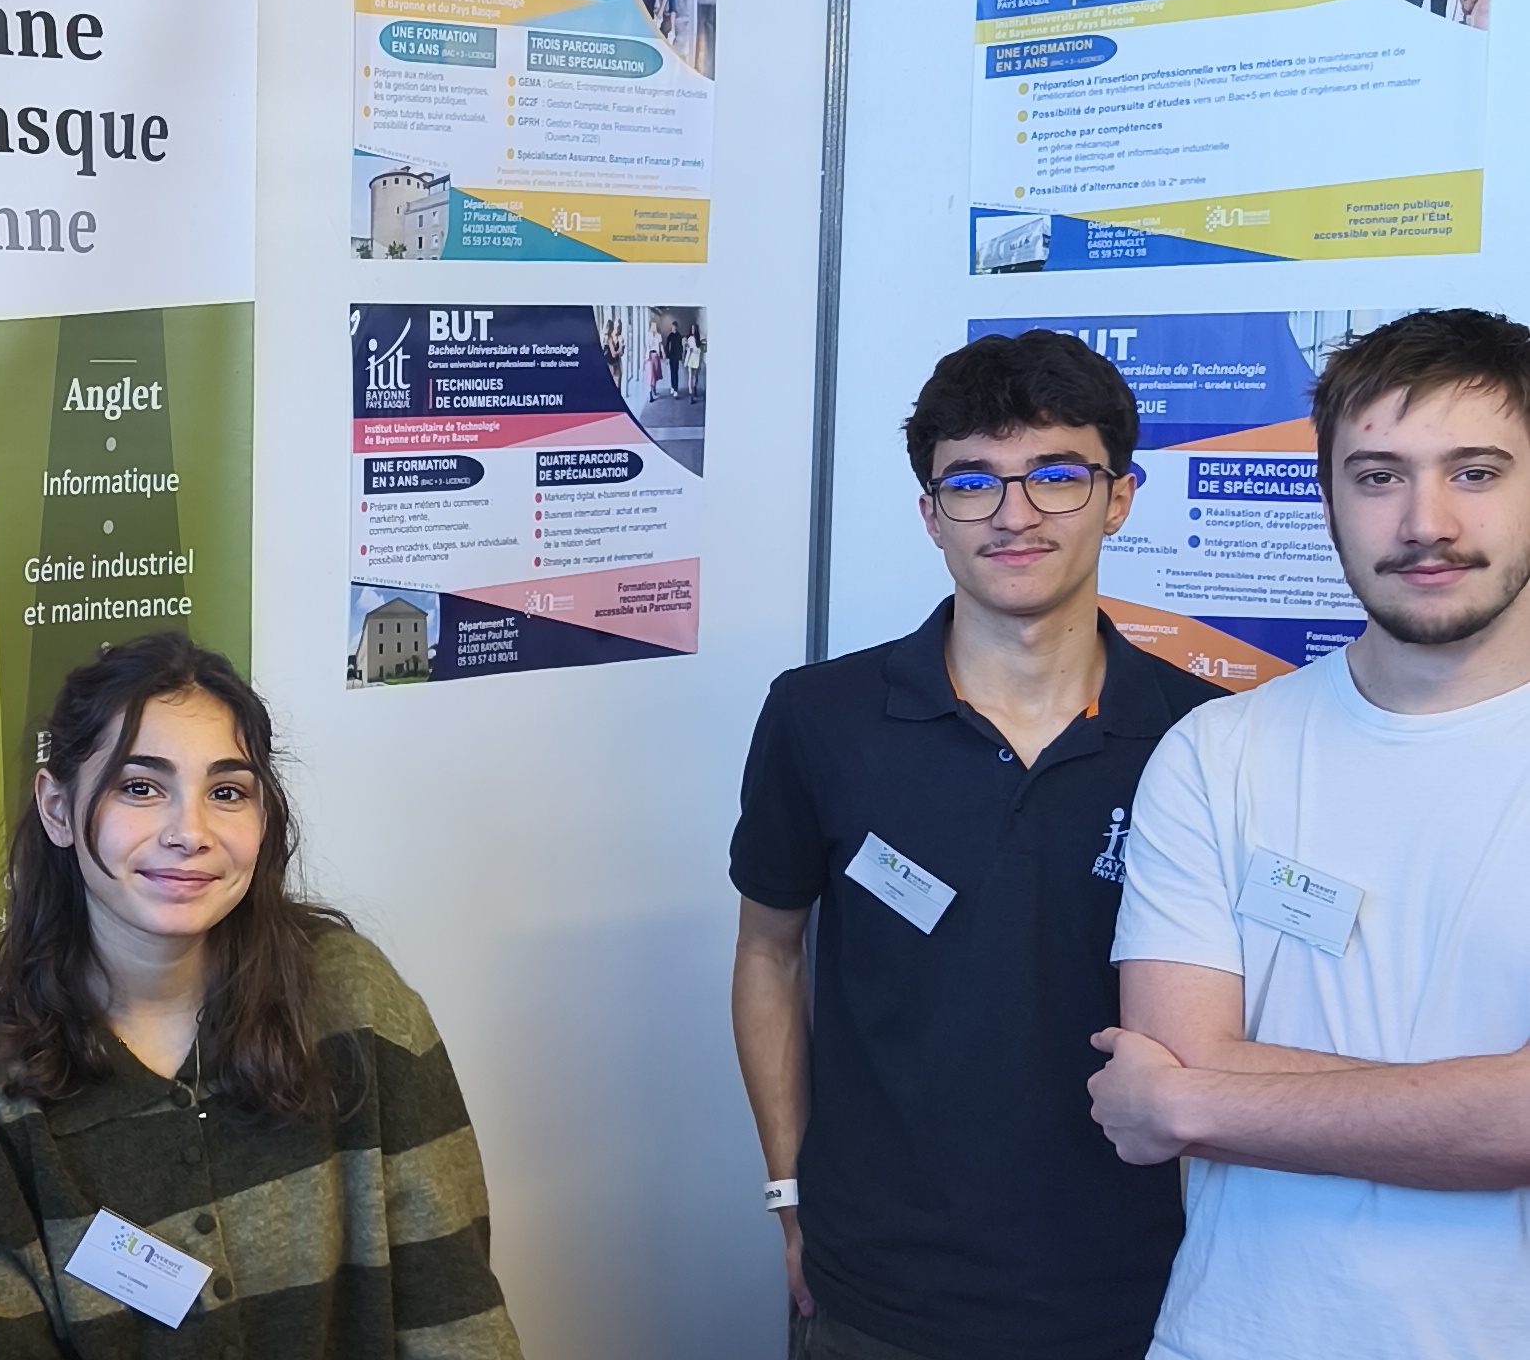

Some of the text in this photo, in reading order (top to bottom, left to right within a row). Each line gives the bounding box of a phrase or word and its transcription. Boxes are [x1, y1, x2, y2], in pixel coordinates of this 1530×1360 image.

[392, 26, 477, 44] UNE FORMATION
[392, 41, 440, 57] EN 3 ANS
[530, 36, 616, 56] TROIS PARCOURS
[530, 53, 543, 65] ET
[545, 54, 566, 68] UNE
[1032, 57, 1293, 92] Préparation à l'insertion professionnelle vers les métiers
[1032, 96, 1191, 120] Possibilité de poursuite d'études
[1031, 120, 1163, 142] Approche par compétences
[1029, 179, 1139, 196] Possibilité d'alternance
[1346, 200, 1400, 213] Formation
[1348, 213, 1398, 226] reconnue
[1400, 213, 1419, 225] par
[1313, 224, 1453, 240] accessible via Parcoursup
[429, 310, 494, 342] B.U.T.
[428, 344, 580, 357] Bachelor Universitaire de Technologie
[436, 378, 504, 392] TECHNIQUES
[63, 376, 162, 420] Anglet
[435, 394, 564, 409] DE COMMERCIALISATION
[539, 452, 629, 467] QUATRE PARCOURS
[539, 466, 629, 481] DE SPÉCIALISATION
[42, 467, 180, 498] Informatique
[24, 549, 194, 583] Génie industriel
[24, 596, 192, 626] et maintenance
